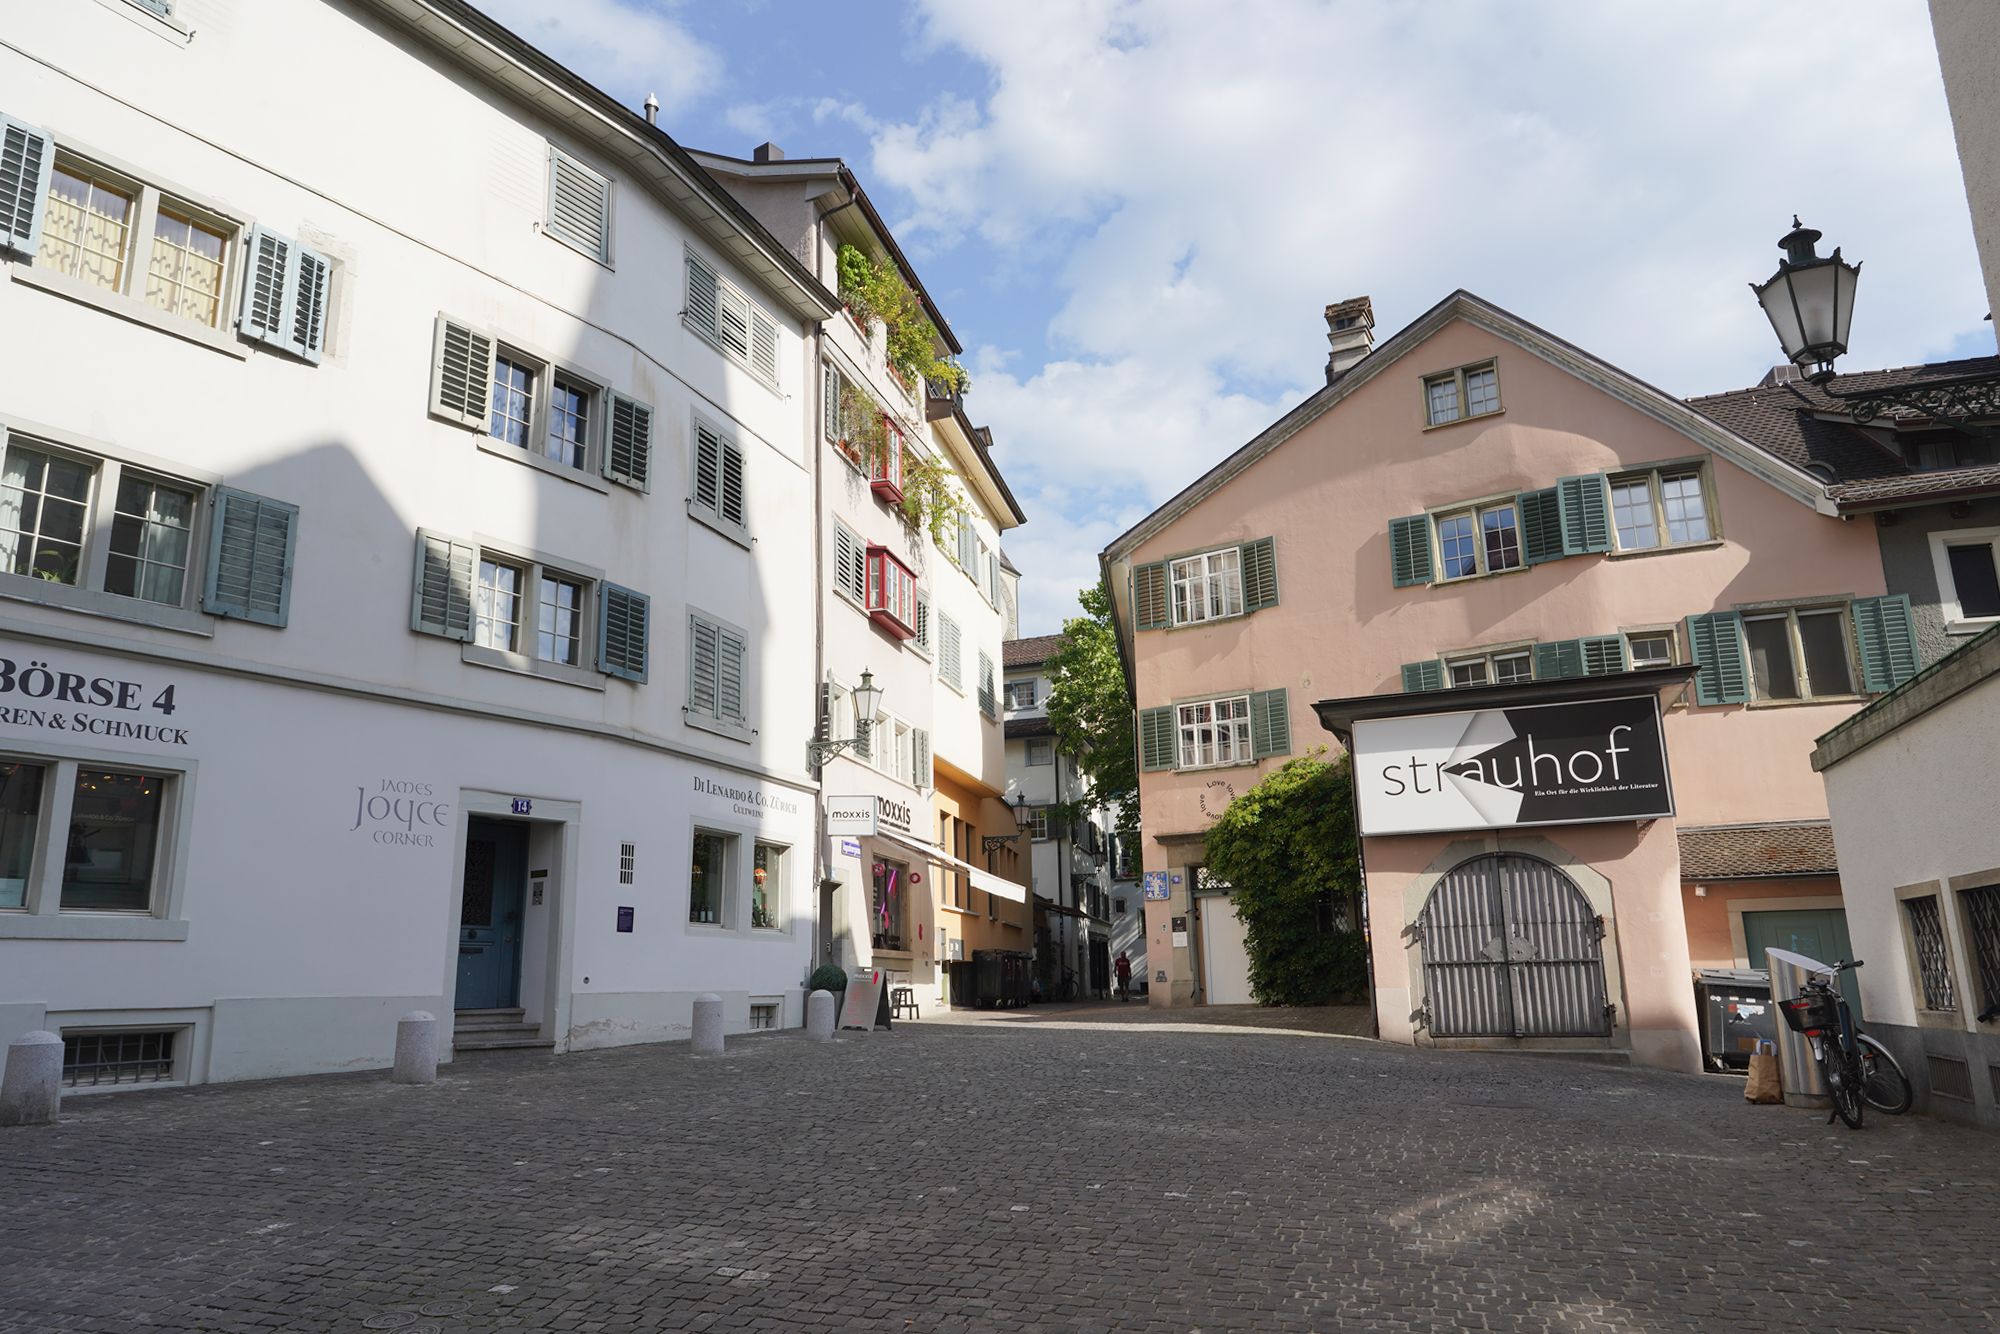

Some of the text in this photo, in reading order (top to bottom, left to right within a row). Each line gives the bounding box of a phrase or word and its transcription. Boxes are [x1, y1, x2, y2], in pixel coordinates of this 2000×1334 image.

[0, 658, 176, 716] BÖRSE 4
[48, 713, 67, 729] &
[71, 712, 189, 745] SCHMUCK
[1383, 725, 1632, 796] strauhof
[381, 779, 433, 796] JAMES
[706, 779, 747, 802] LENARDO
[747, 790, 755, 805] &
[1579, 784, 1617, 793] Wirklichkeit
[1630, 782, 1659, 790] Literatur
[517, 801, 528, 813] 14
[832, 809, 870, 819] moxxis
[373, 830, 434, 848] CORNER
